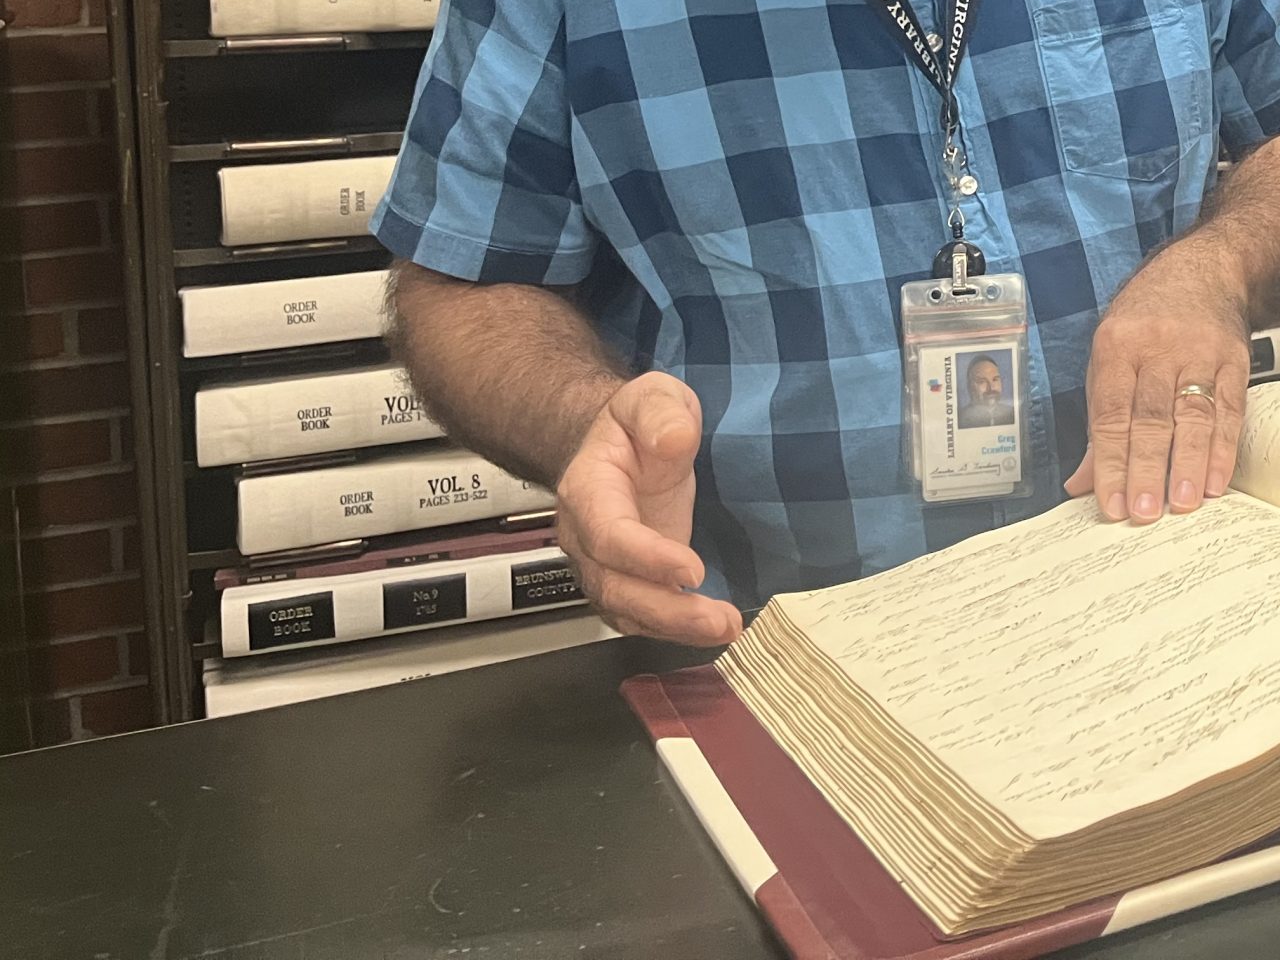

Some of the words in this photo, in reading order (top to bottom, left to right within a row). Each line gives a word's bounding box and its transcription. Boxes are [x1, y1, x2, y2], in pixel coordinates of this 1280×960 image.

[887, 1, 942, 86] LIBRARY
[340, 187, 350, 216] ORDER
[355, 190, 365, 212] BOOK
[283, 300, 318, 314] ORDER
[286, 312, 316, 325] BOOK
[944, 356, 953, 399] VIRGINIA
[296, 406, 332, 421] ORDER
[946, 400, 954, 413] OF
[300, 418, 330, 432] BOOK
[381, 412, 413, 425] PAGES
[946, 415, 955, 458] LIBRARY
[427, 475, 465, 495] VOL.
[472, 474, 481, 490] 8
[339, 491, 374, 506] ORDER
[419, 495, 450, 509] PAGES
[344, 503, 374, 517] BOOK
[269, 606, 314, 624] ORDER
[273, 620, 312, 637] BOOK
